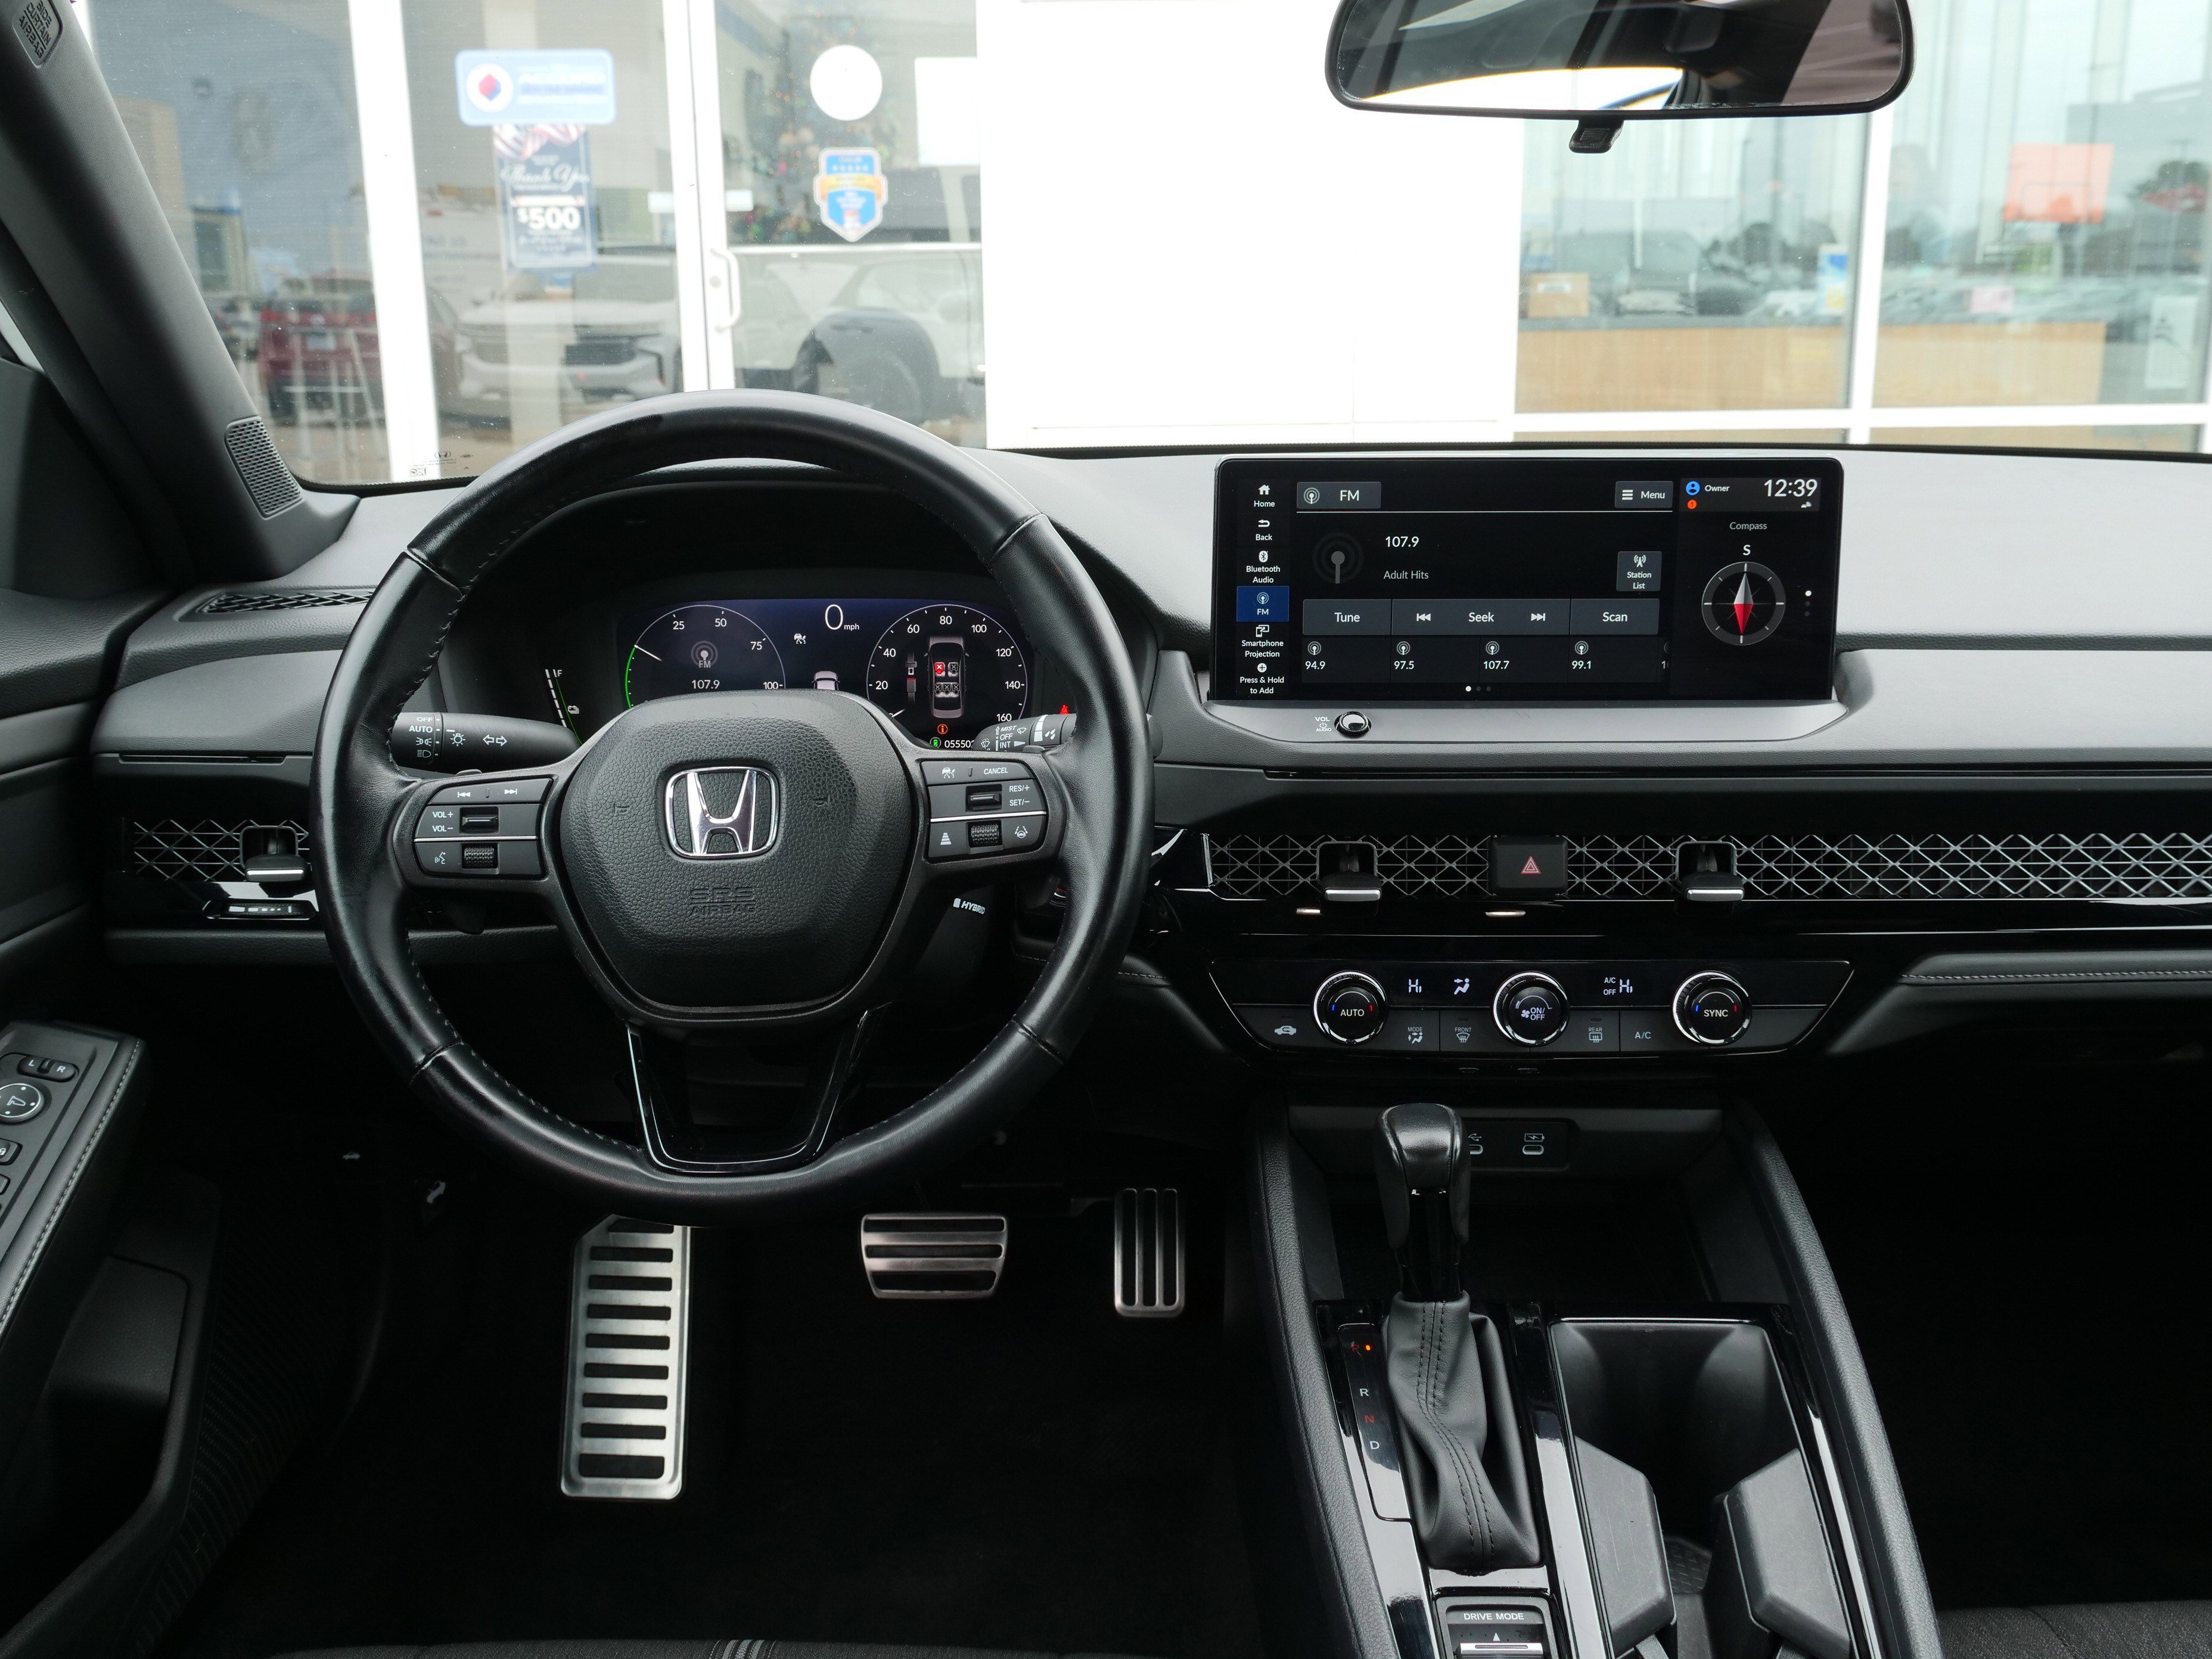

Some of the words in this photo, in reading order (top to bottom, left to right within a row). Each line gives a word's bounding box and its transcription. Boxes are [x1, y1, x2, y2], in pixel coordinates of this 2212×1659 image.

[19, 15, 44, 58] AIRBAG
[517, 206, 581, 230] $500
[1764, 479, 1818, 496] 12:39
[1340, 490, 1359, 501] FM
[1730, 522, 1767, 531] Compass
[1385, 536, 1419, 547] 107.9
[1743, 545, 1750, 555] S
[1384, 570, 1408, 579] Adult
[825, 604, 843, 630] 0
[940, 616, 952, 625] 80
[1334, 613, 1360, 622] Tune
[1469, 612, 1494, 622] Seek
[1603, 612, 1627, 622] Scan
[673, 621, 684, 629] 25
[715, 619, 726, 627] 50
[908, 625, 919, 633] 60
[883, 648, 896, 657] 40
[996, 648, 1011, 657] 120
[1306, 661, 1325, 669] 94.9
[1394, 661, 1414, 669] 97.5
[1484, 661, 1509, 669] 107.7
[692, 680, 719, 689] 107.9
[763, 681, 779, 689] 100
[876, 681, 888, 689] 20
[1005, 681, 1021, 689] 140
[996, 713, 1012, 722] 160
[984, 767, 1008, 775] CANCEL
[961, 901, 986, 915] HYBRID
[1365, 1415, 1375, 1423] N
[1370, 1441, 1380, 1449] D
[1463, 1613, 1493, 1621] DRIVE
[1496, 1613, 1525, 1621] MODE
